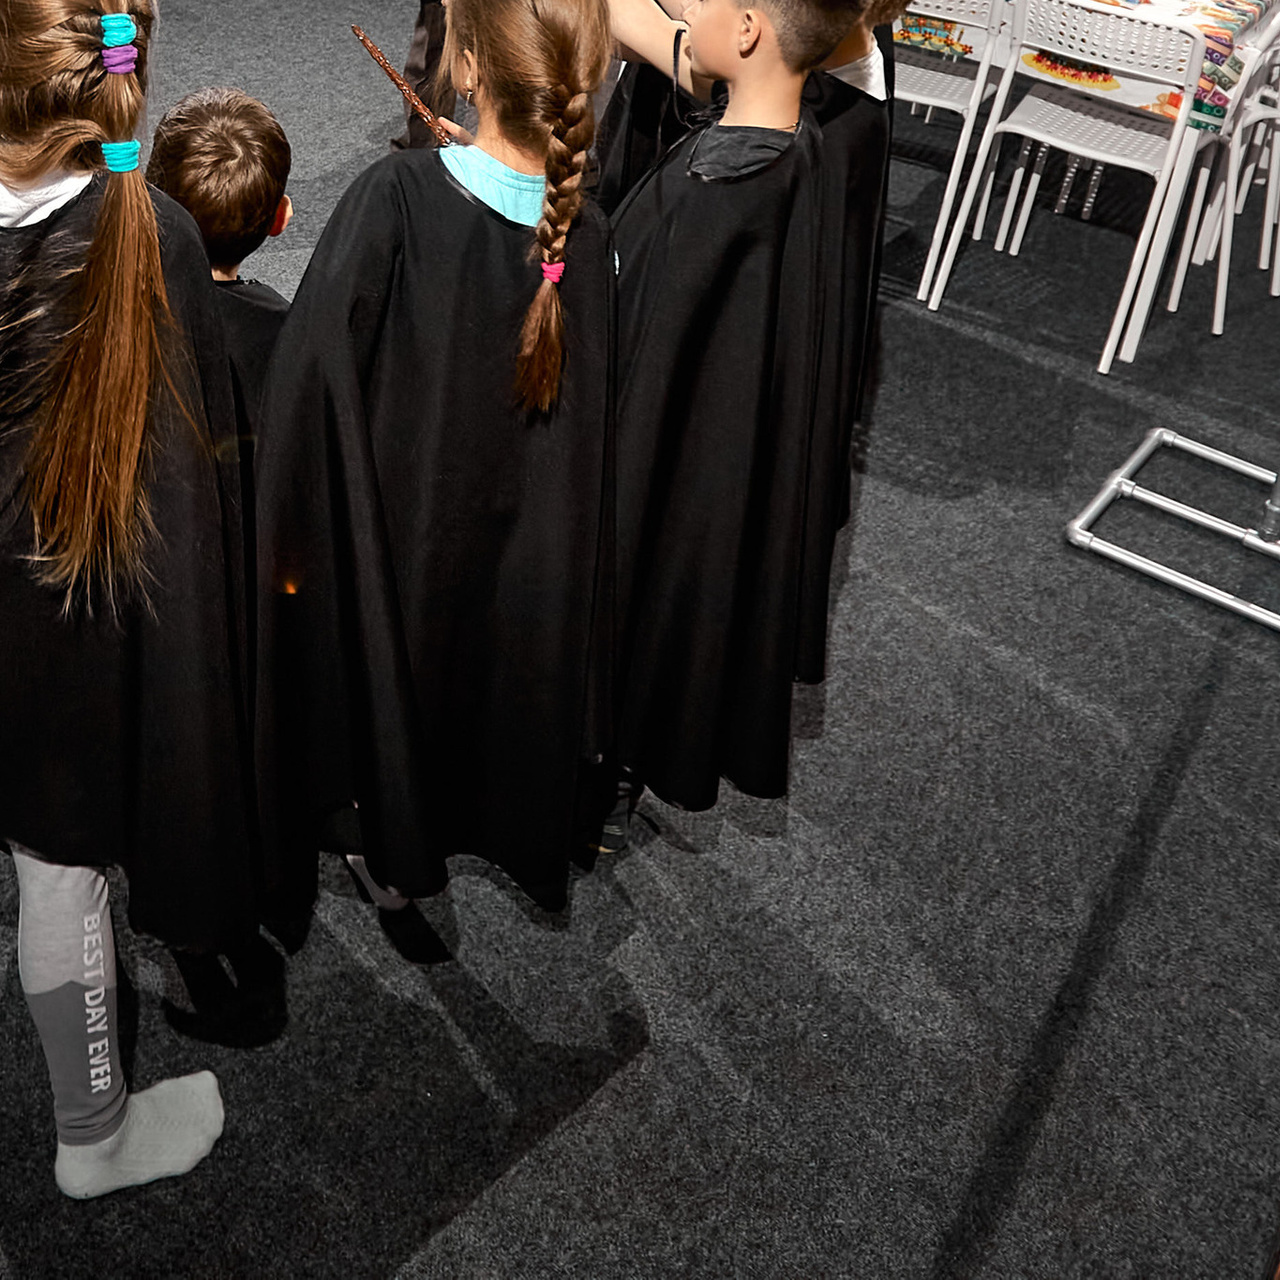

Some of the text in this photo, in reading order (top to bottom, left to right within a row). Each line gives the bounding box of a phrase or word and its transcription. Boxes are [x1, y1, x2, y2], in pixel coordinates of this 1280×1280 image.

[83, 912, 112, 1094] BEST DAY EVER
